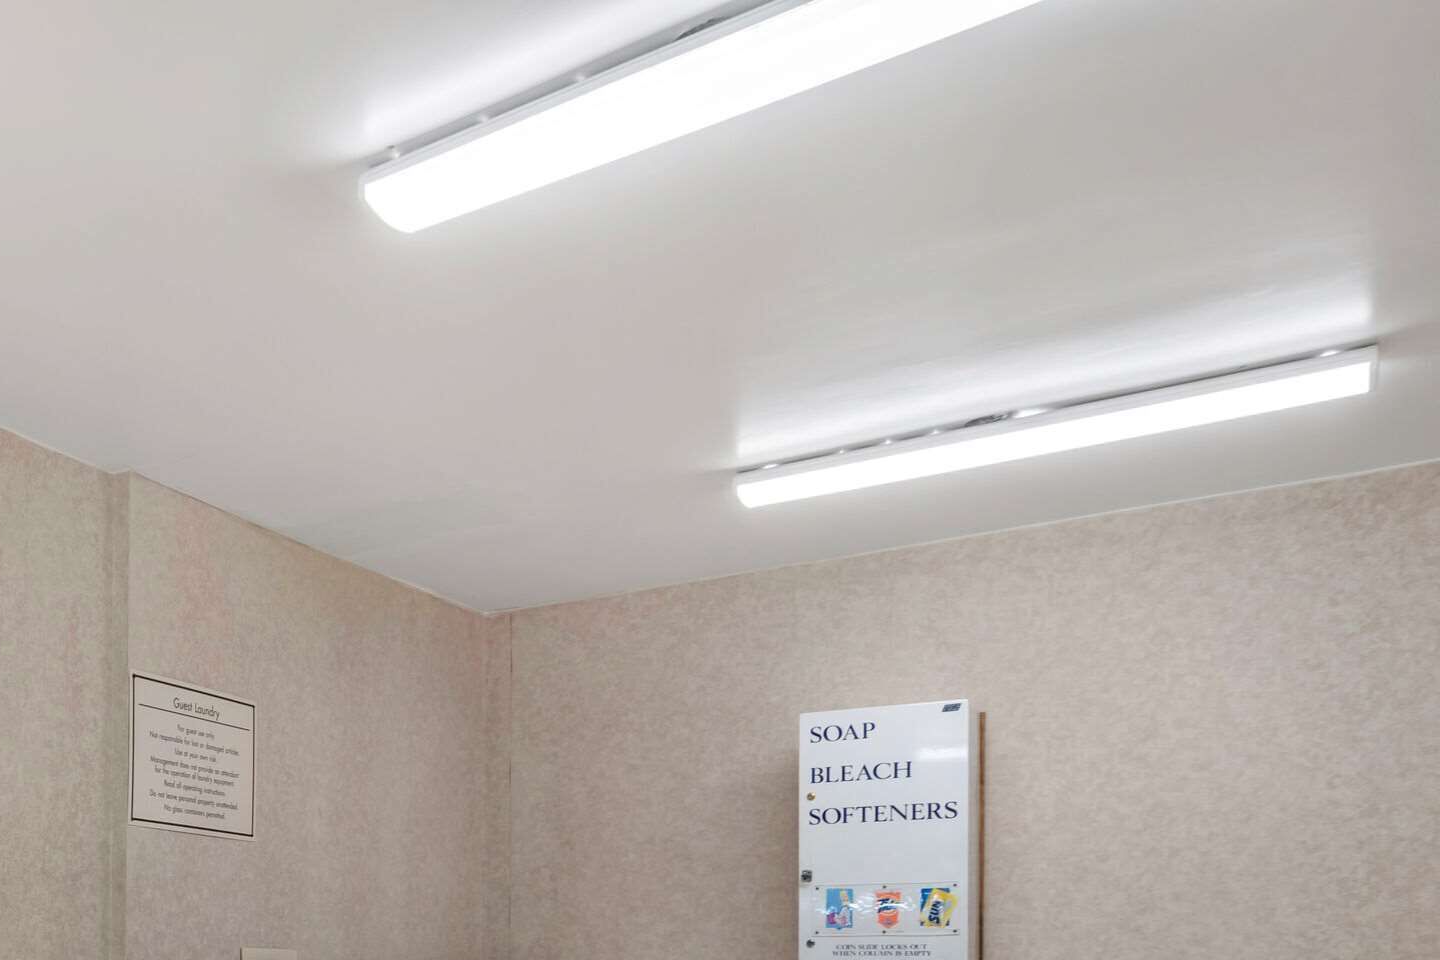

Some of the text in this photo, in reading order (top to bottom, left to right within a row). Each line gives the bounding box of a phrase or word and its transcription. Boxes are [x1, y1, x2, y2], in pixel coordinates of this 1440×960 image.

[195, 703, 220, 721] Laundry
[809, 721, 876, 744] SOAP
[809, 760, 913, 785] BLEACH
[808, 801, 959, 826] SOFTENERS
